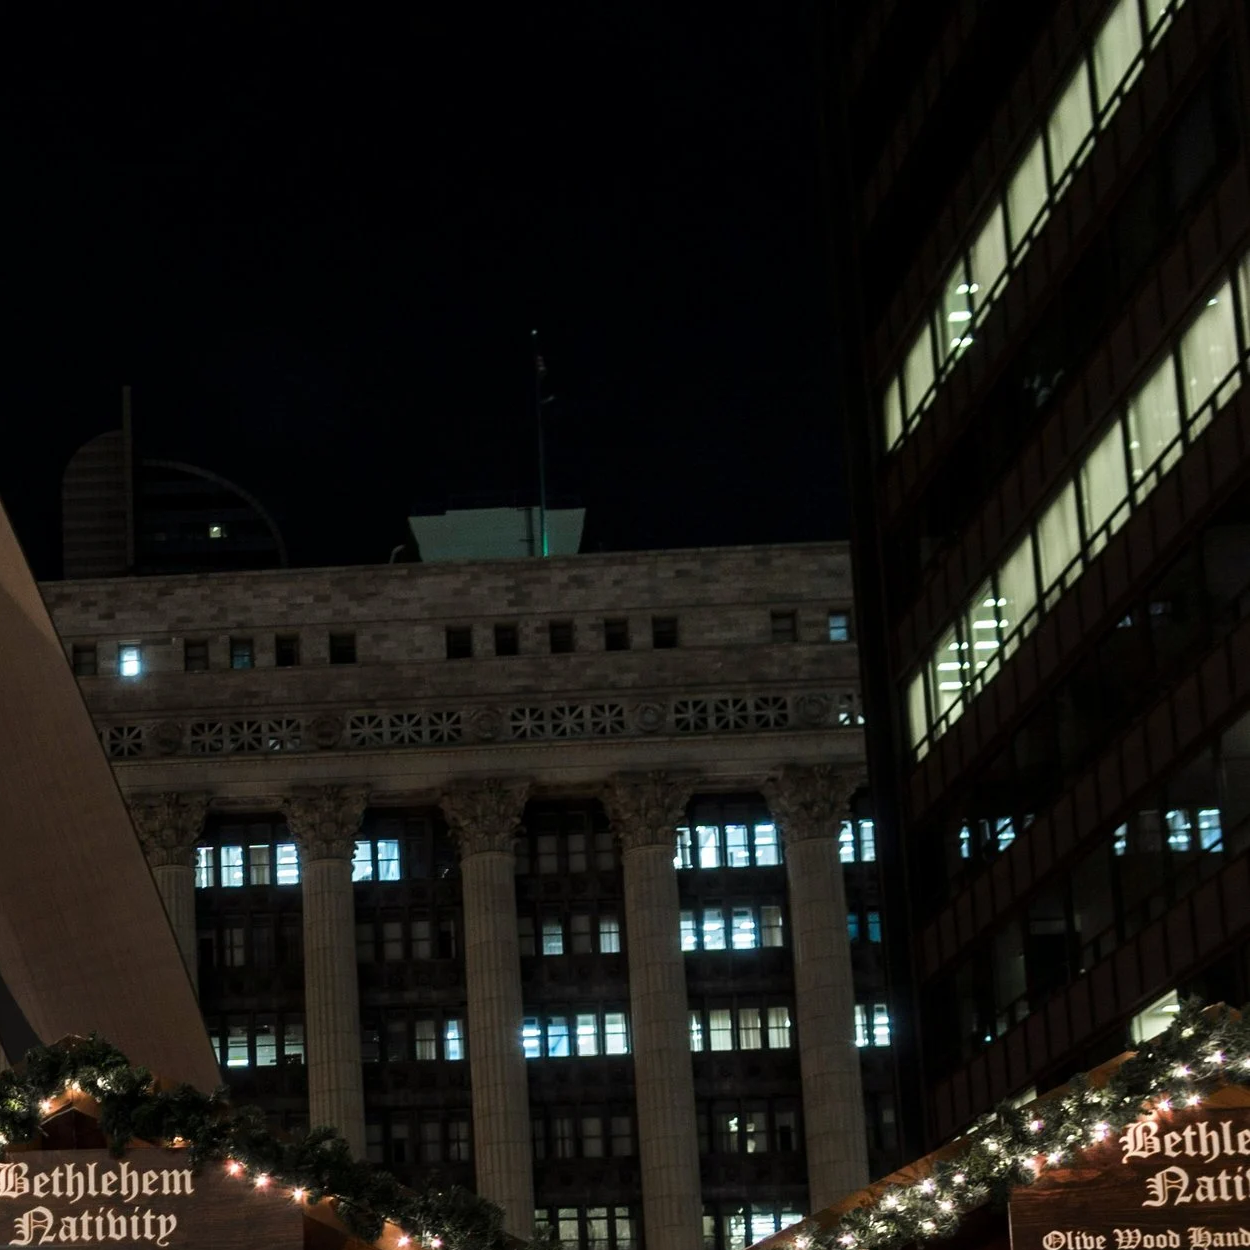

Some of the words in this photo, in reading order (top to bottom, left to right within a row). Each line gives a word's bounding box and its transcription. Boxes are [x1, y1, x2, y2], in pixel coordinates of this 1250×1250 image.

[1142, 1165, 1250, 1207] Nati
[8, 1205, 177, 1247] Nativity
[1042, 1230, 1107, 1250] Olive
[1113, 1228, 1181, 1250] Wood
[1187, 1226, 1250, 1250] Hand
